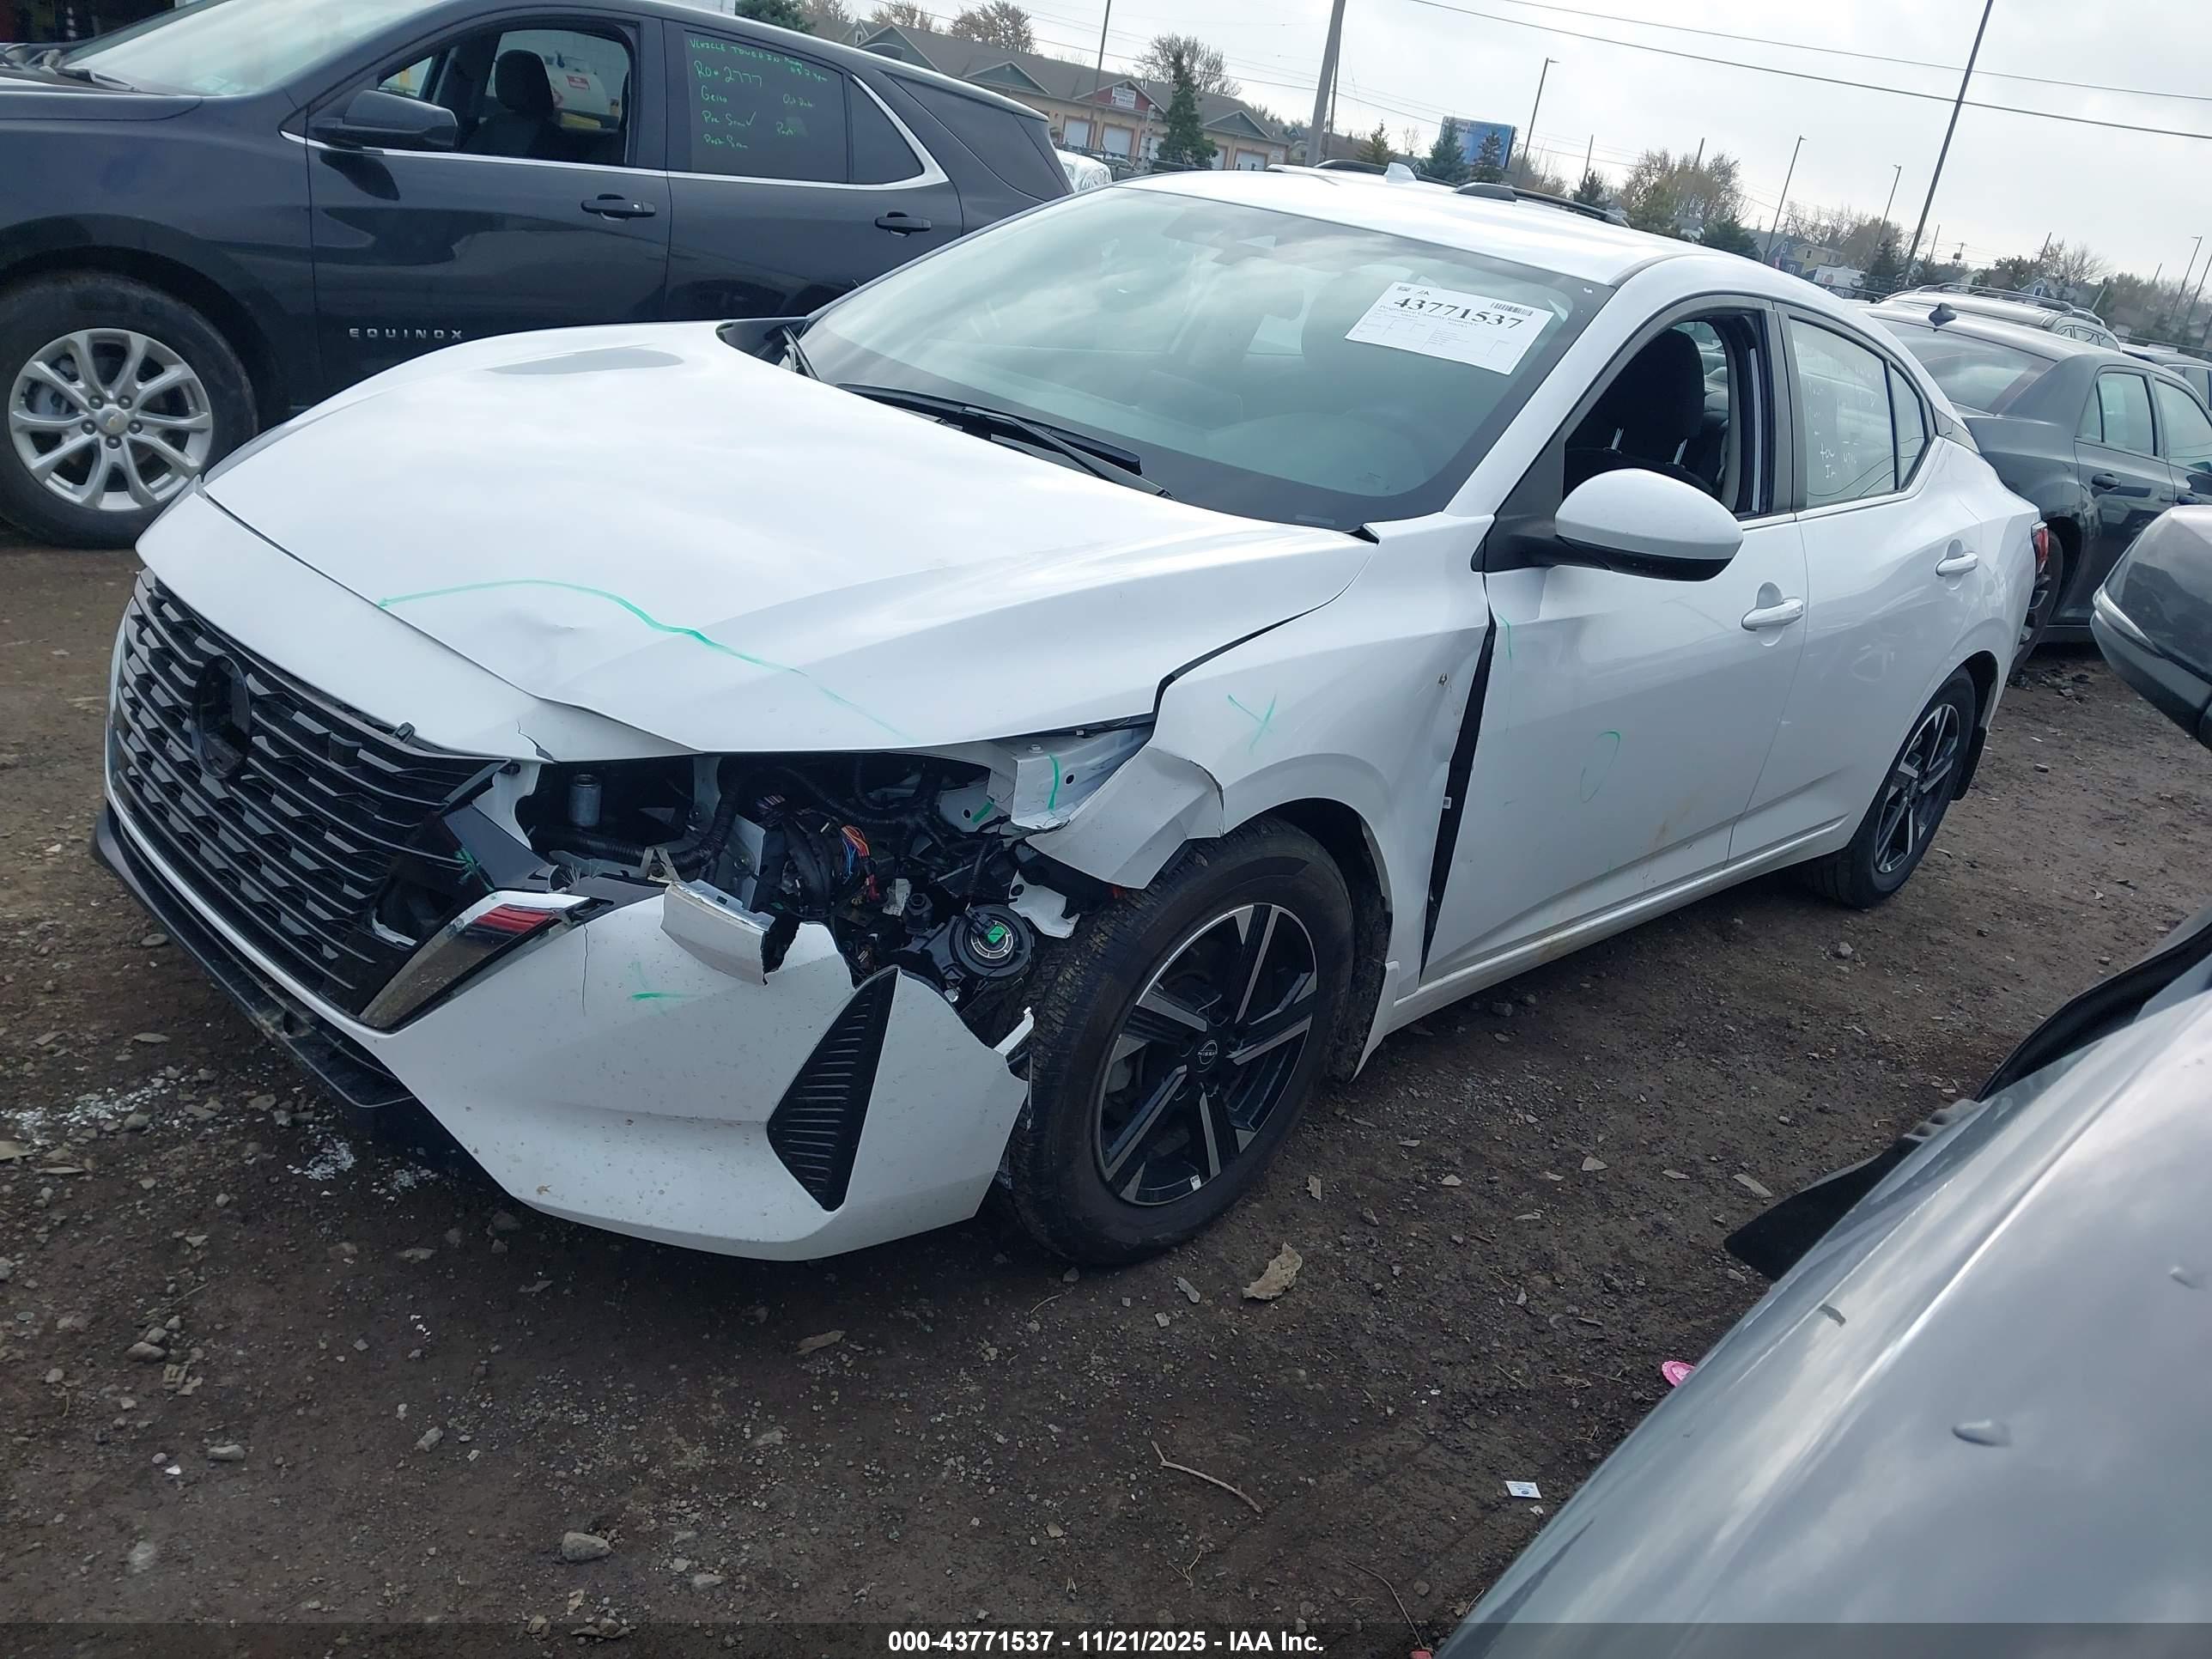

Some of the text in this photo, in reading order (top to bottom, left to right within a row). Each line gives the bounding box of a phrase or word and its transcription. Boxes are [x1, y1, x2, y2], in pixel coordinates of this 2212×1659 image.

[690, 39, 726, 52] VEHICLE
[1394, 297, 1524, 329] 43771537
[349, 328, 462, 339] EQUINOX
